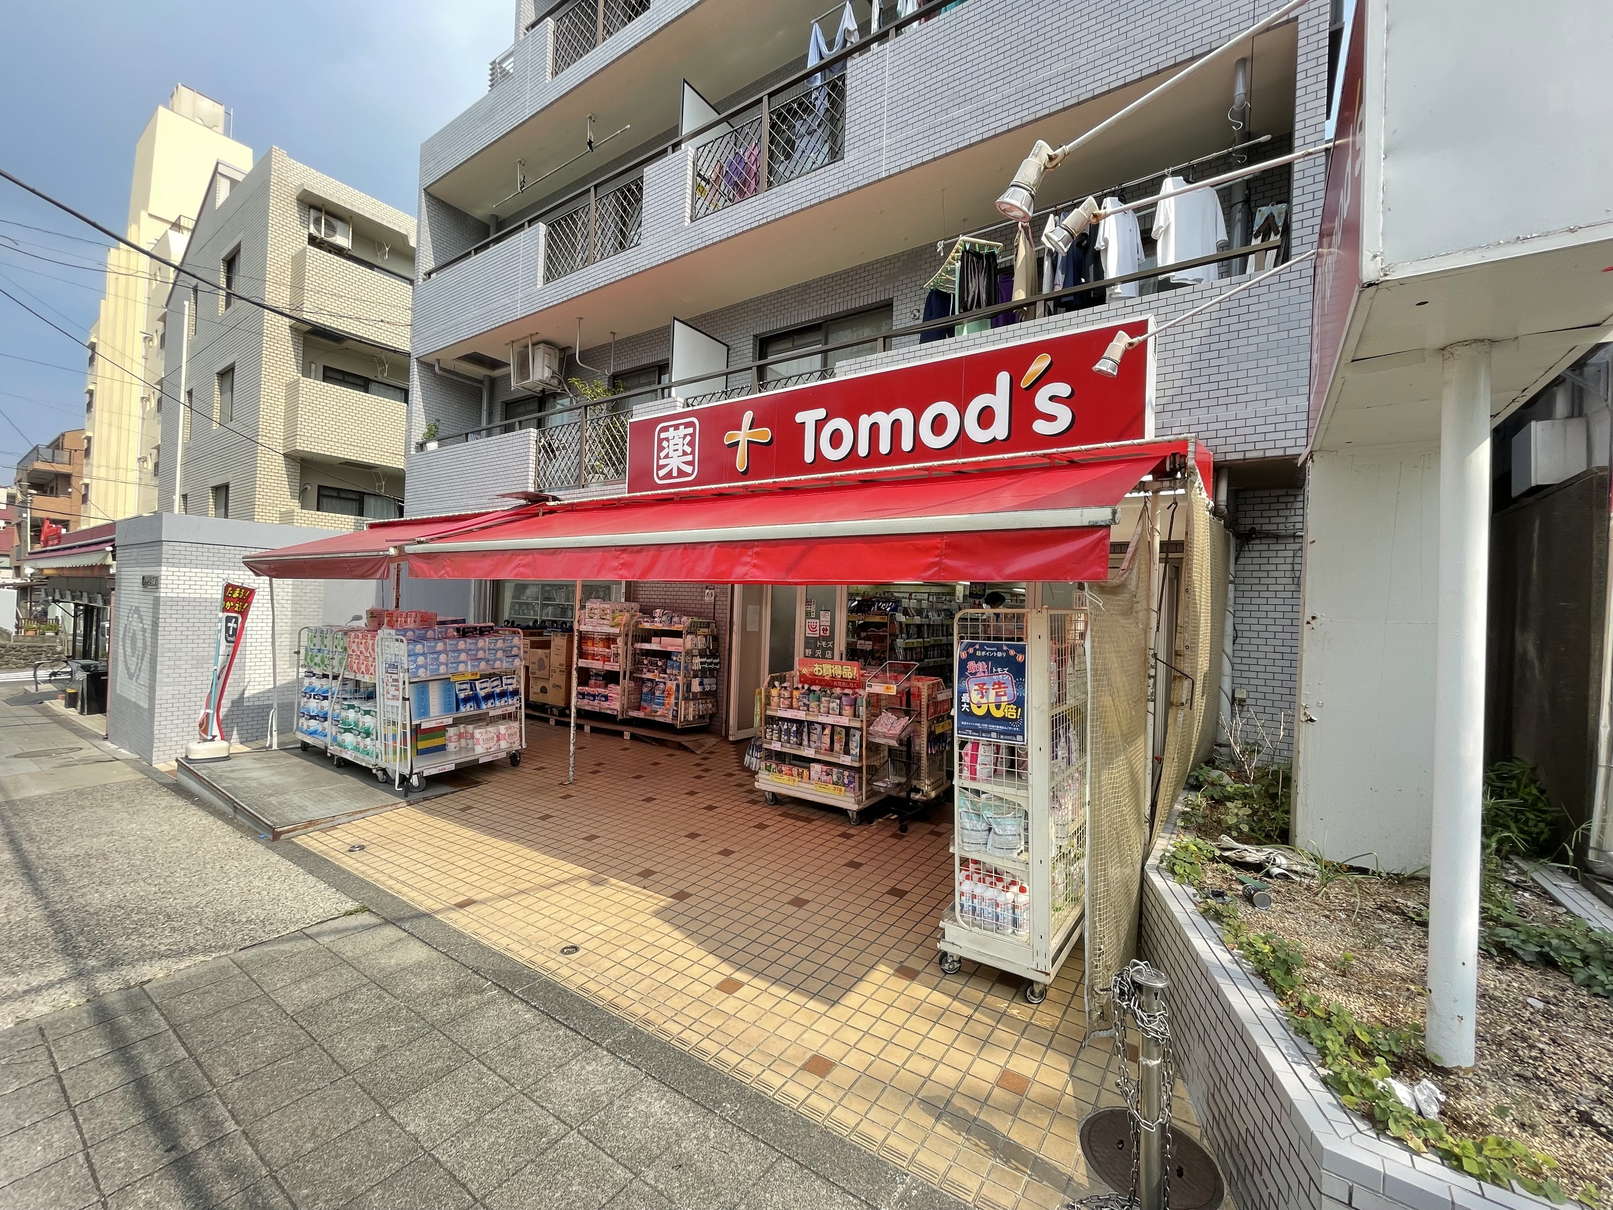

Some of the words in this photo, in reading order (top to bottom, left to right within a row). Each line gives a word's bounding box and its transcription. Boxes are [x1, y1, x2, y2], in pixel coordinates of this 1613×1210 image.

[795, 353, 1075, 464] Tomod's
[657, 423, 696, 478] 薬
[805, 648, 832, 658] 野沢店
[817, 640, 833, 648] トモズ
[973, 680, 1009, 699] 予告
